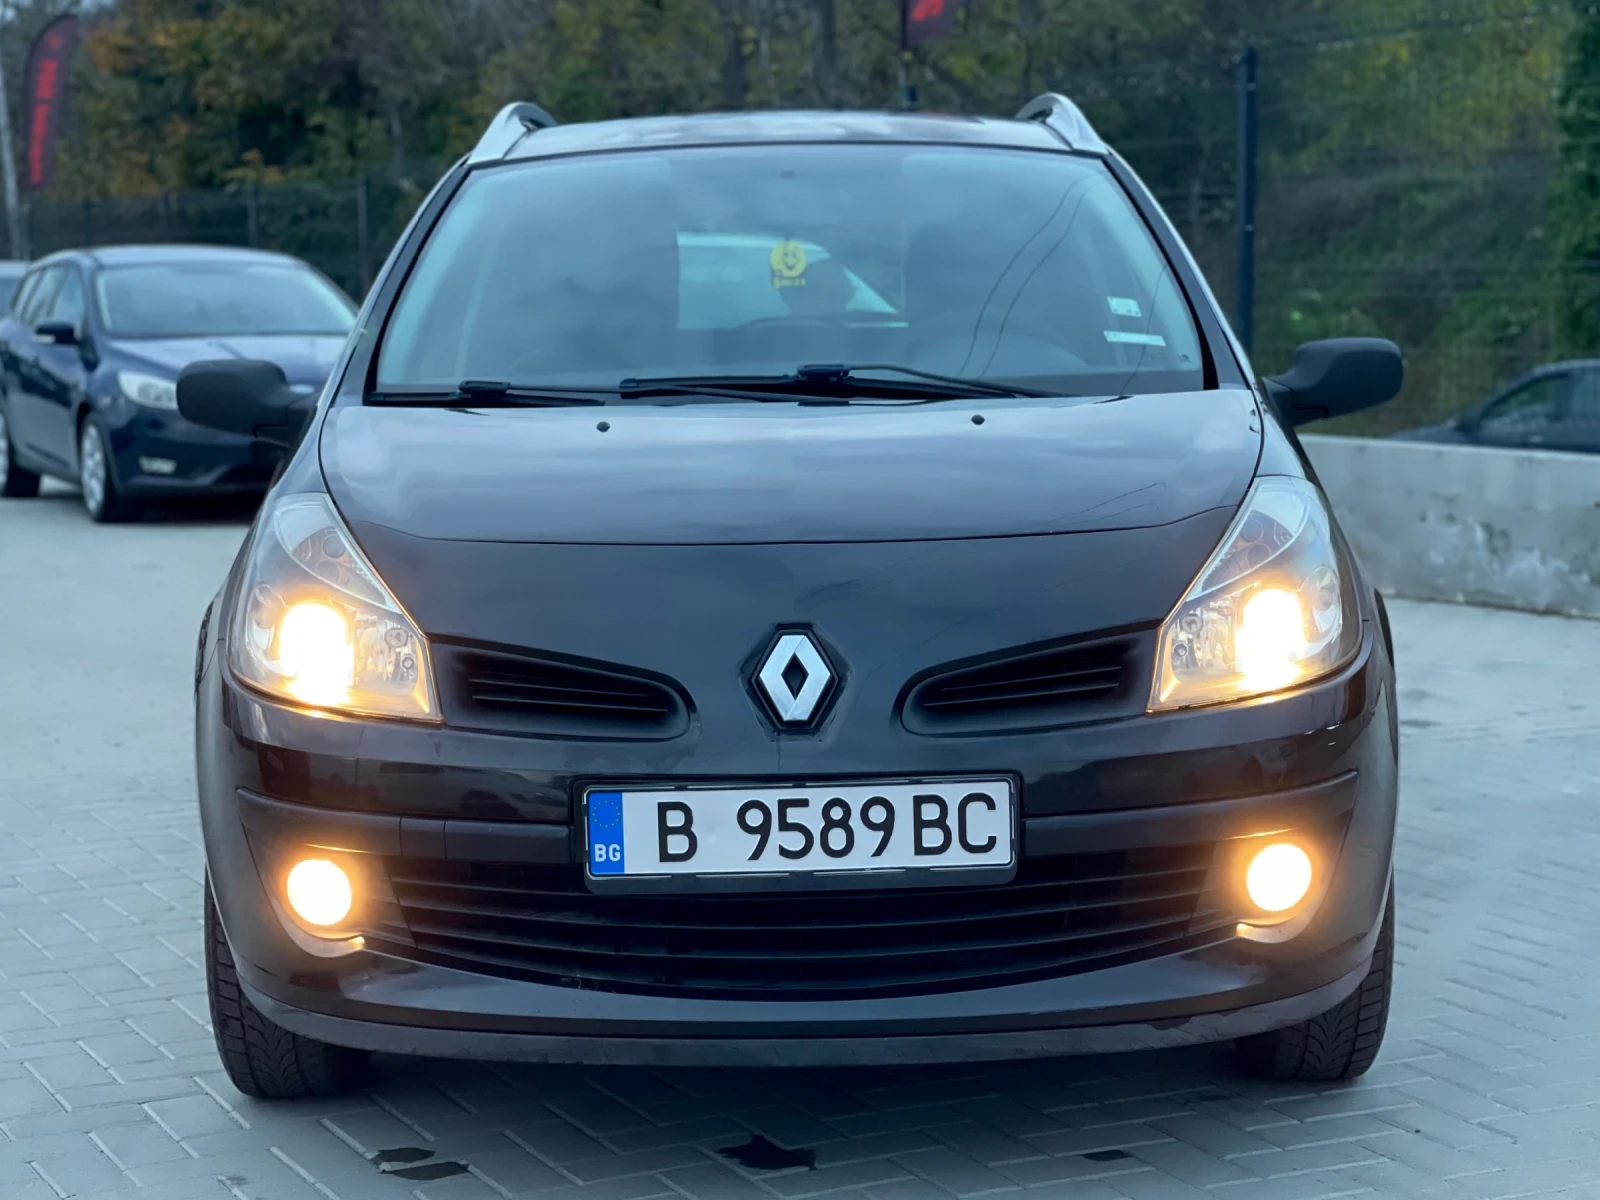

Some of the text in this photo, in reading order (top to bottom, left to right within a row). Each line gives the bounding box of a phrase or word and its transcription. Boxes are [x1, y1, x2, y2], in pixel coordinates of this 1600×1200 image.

[657, 792, 997, 863] B 9589 BC
[594, 843, 621, 862] BG
